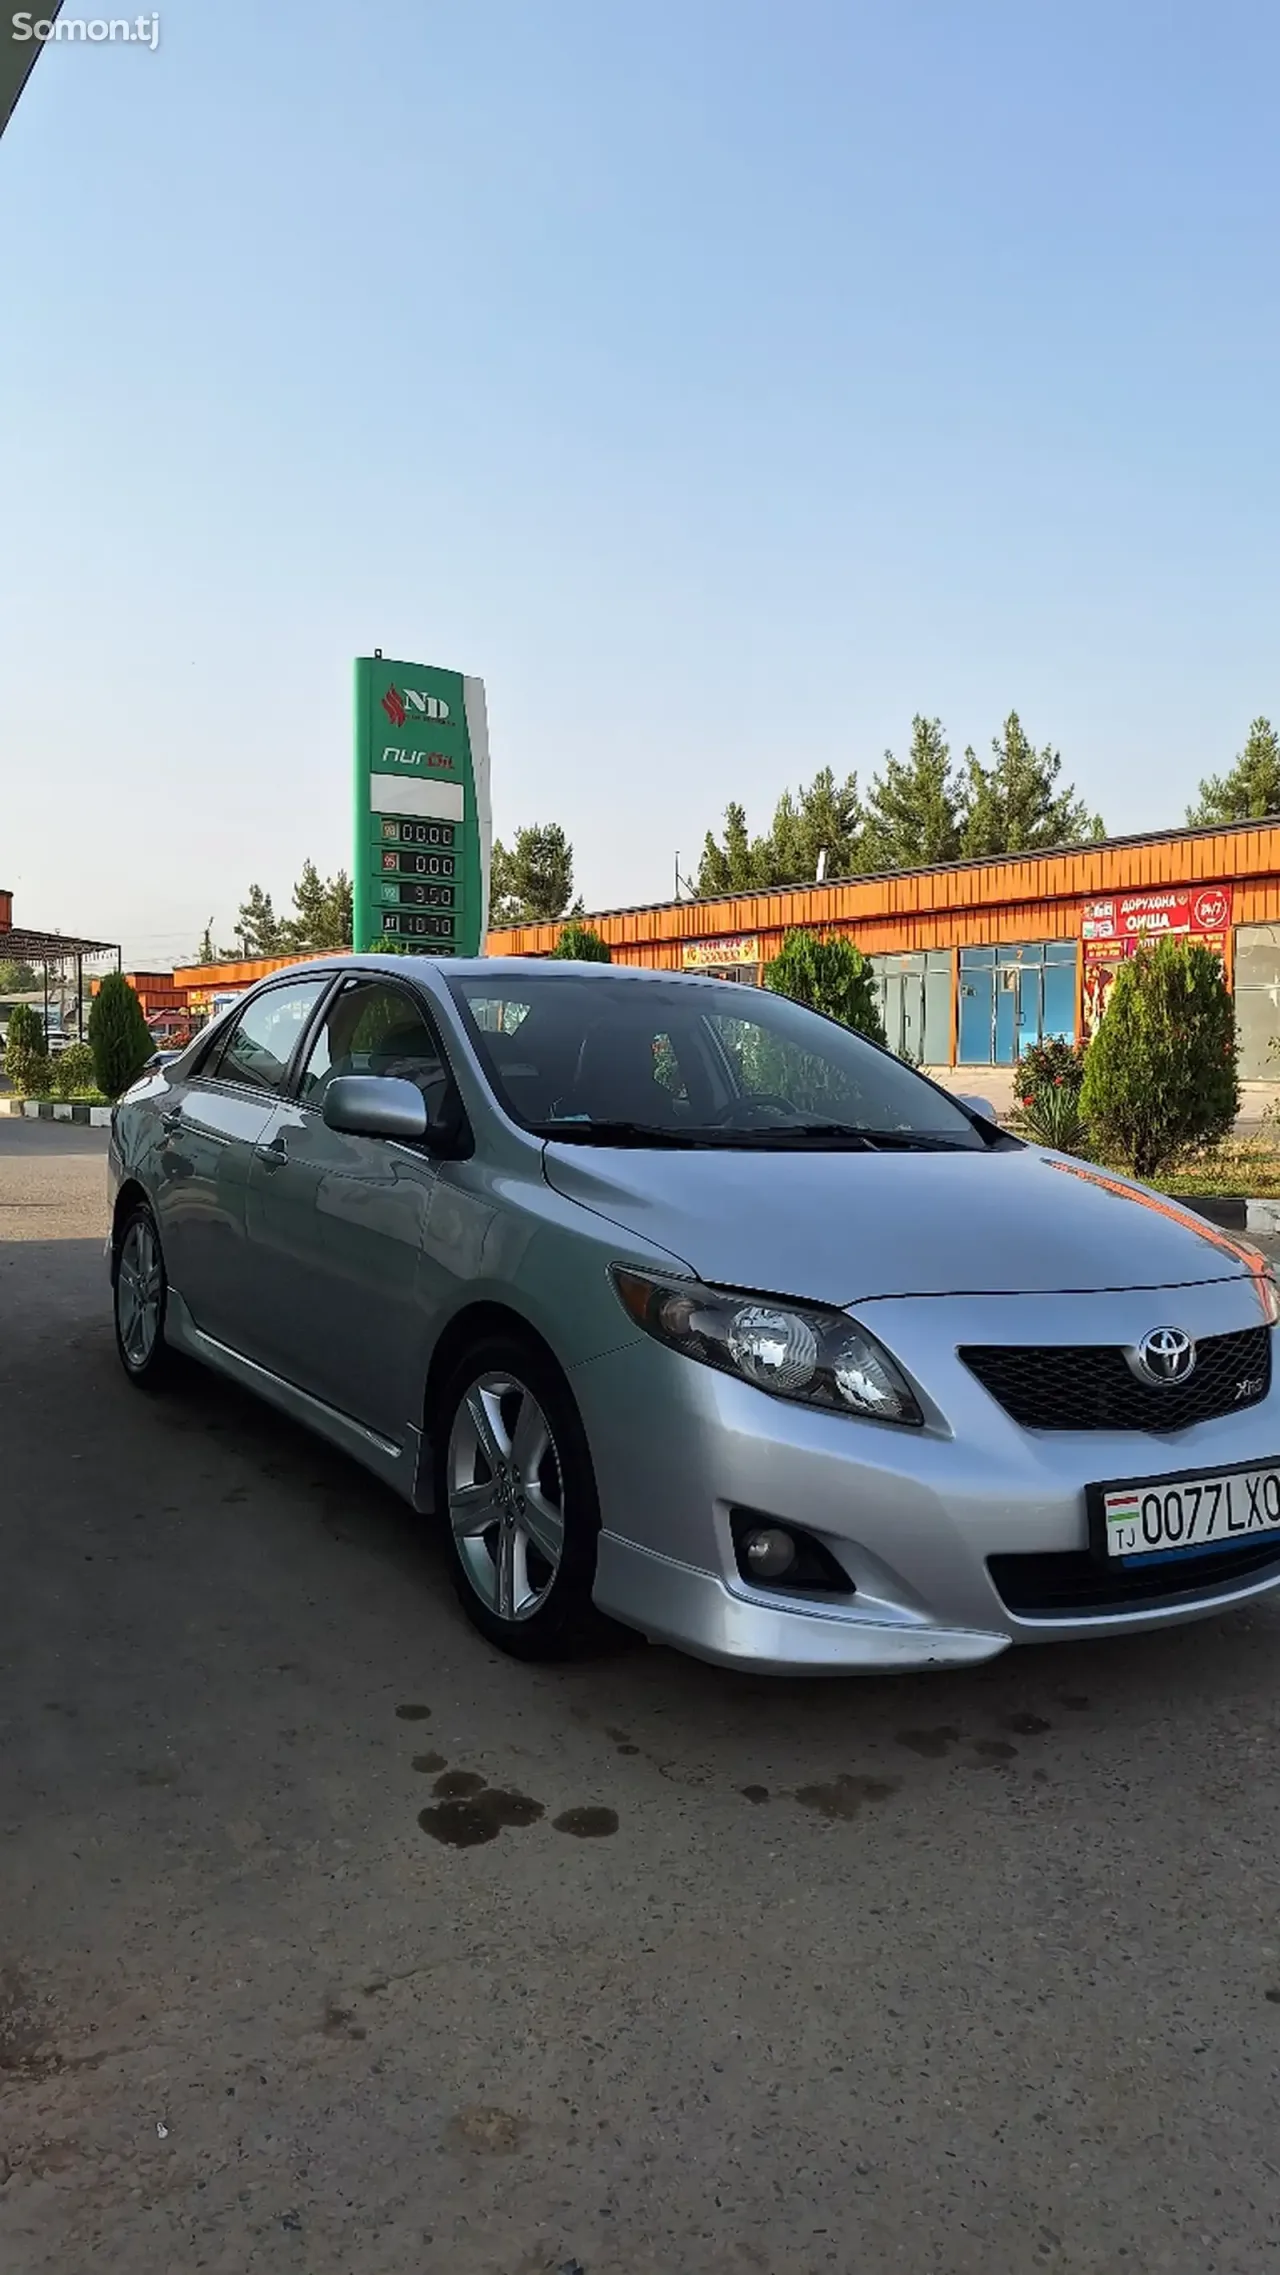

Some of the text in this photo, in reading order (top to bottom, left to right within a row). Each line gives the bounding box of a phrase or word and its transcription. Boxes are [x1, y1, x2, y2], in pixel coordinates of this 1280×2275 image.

[402, 688, 450, 719] ND
[416, 855, 453, 876] 0.00
[1120, 895, 1177, 914] ДОРУХОНА
[1115, 1527, 1136, 1549] TJ
